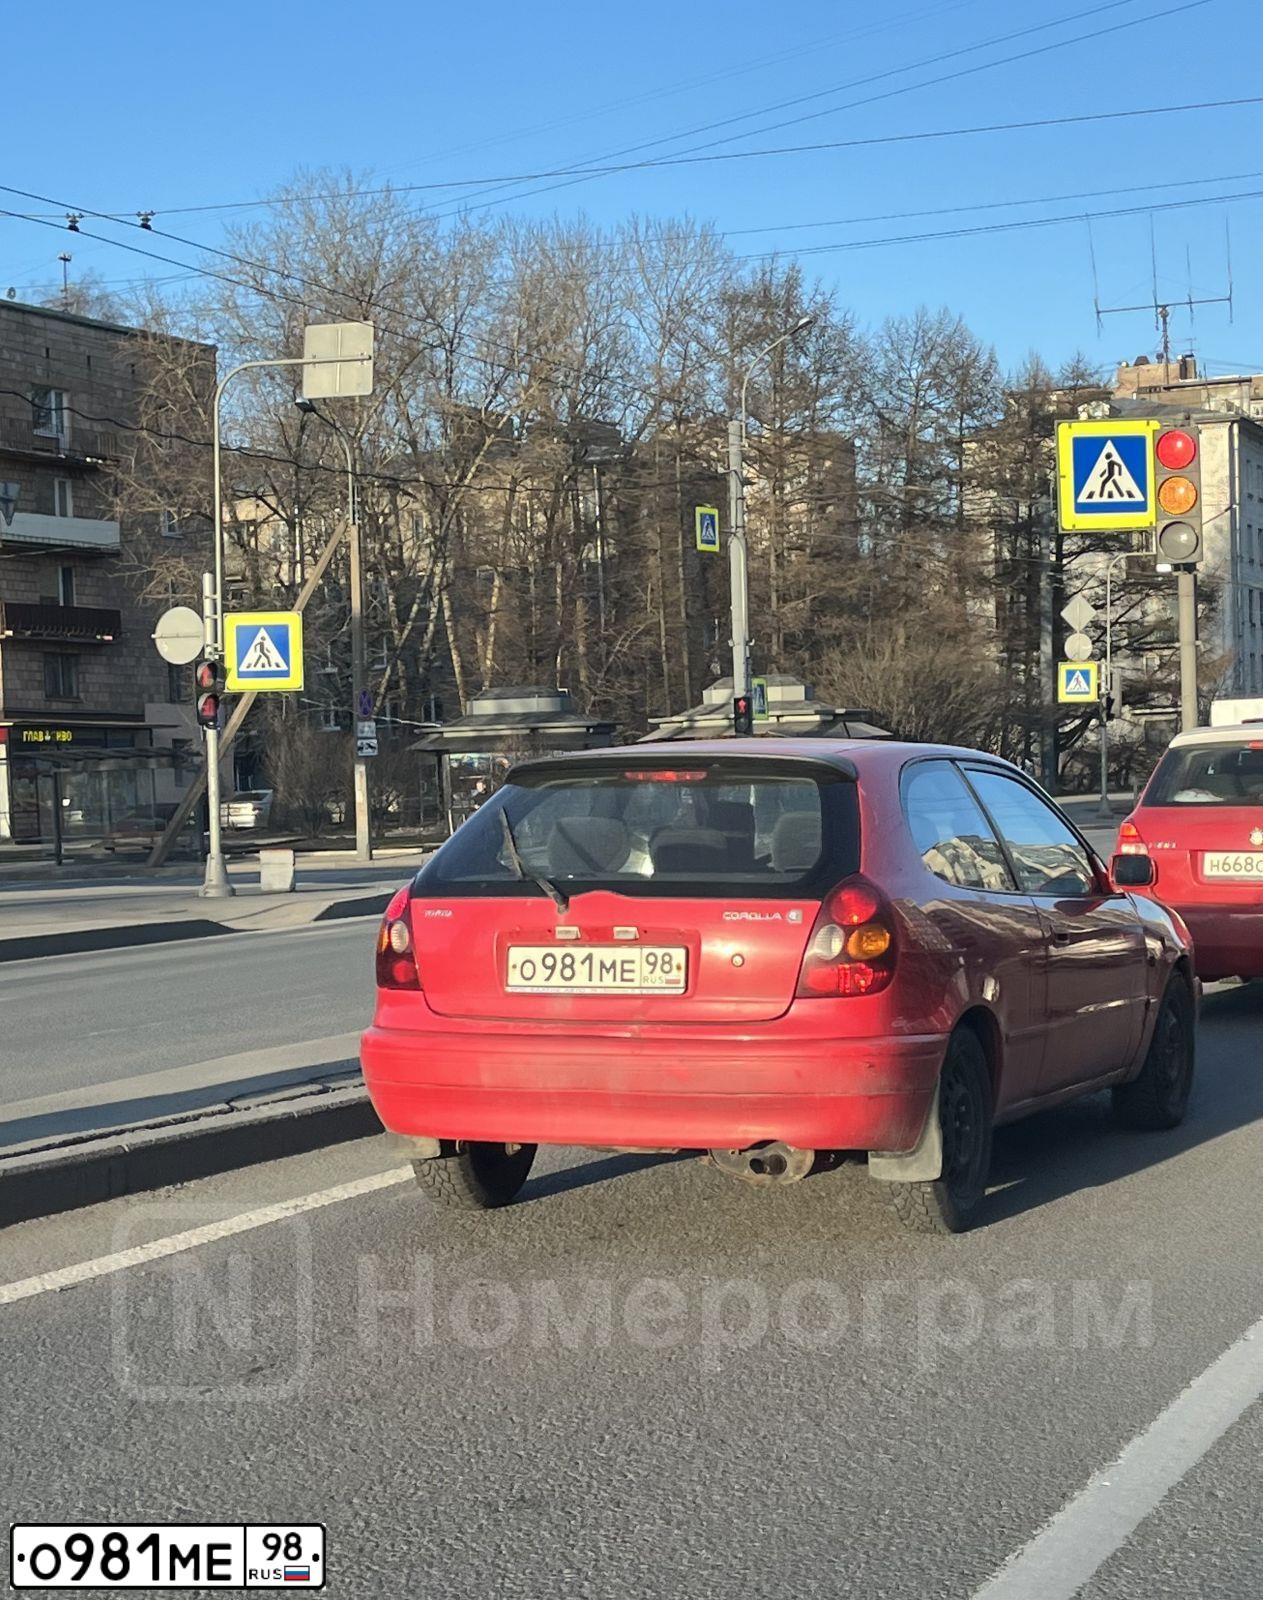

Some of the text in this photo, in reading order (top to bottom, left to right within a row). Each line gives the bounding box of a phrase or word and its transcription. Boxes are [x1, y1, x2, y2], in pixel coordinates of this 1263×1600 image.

[23, 730, 44, 742] ГЛАВ
[723, 911, 782, 920] COROLLA
[520, 952, 674, 983] О981МЕ 98
[642, 976, 664, 985] RUS
